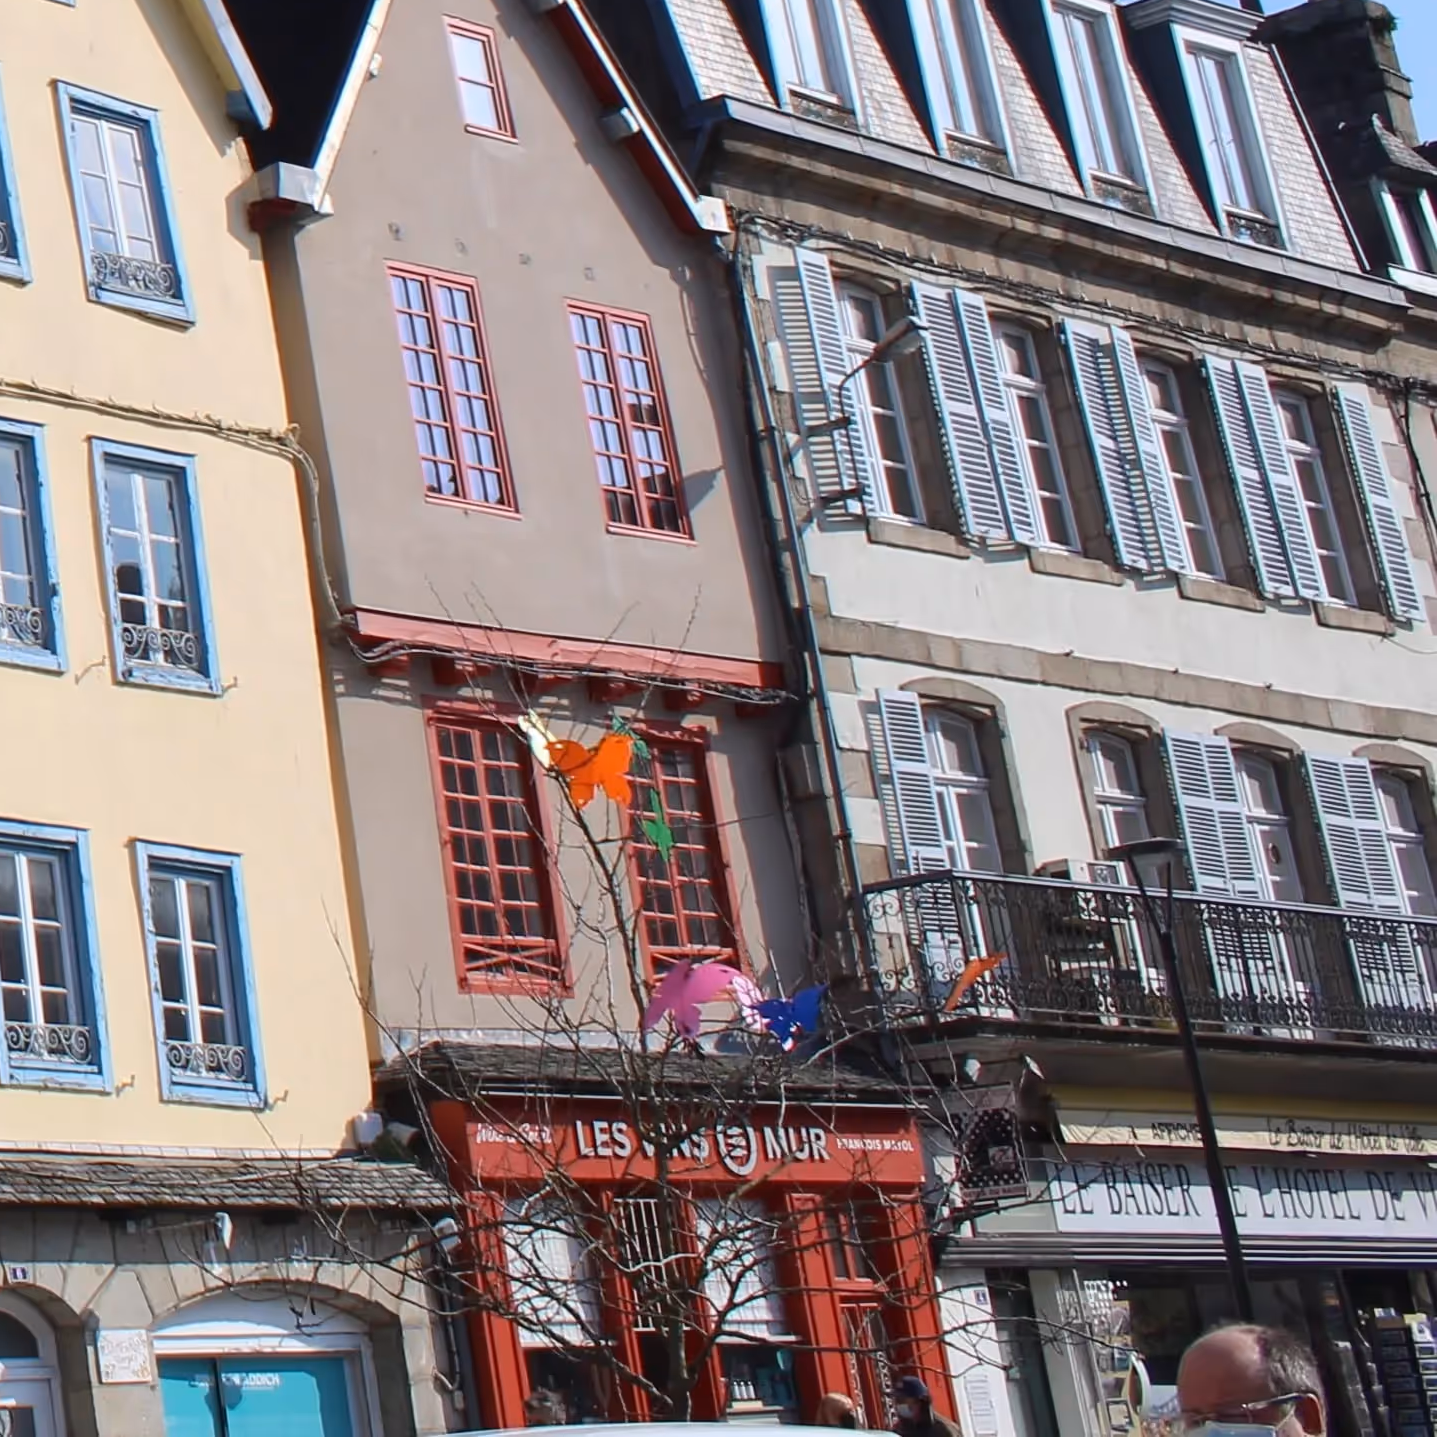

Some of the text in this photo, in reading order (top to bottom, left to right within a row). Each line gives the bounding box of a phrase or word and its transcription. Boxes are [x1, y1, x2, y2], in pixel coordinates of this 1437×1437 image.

[576, 1120, 631, 1158] LES
[763, 1126, 831, 1161] MUR
[1057, 1162, 1094, 1214] LE
[1101, 1161, 1201, 1217] BAISER
[1214, 1165, 1247, 1218] E
[1365, 1171, 1406, 1221] DE
